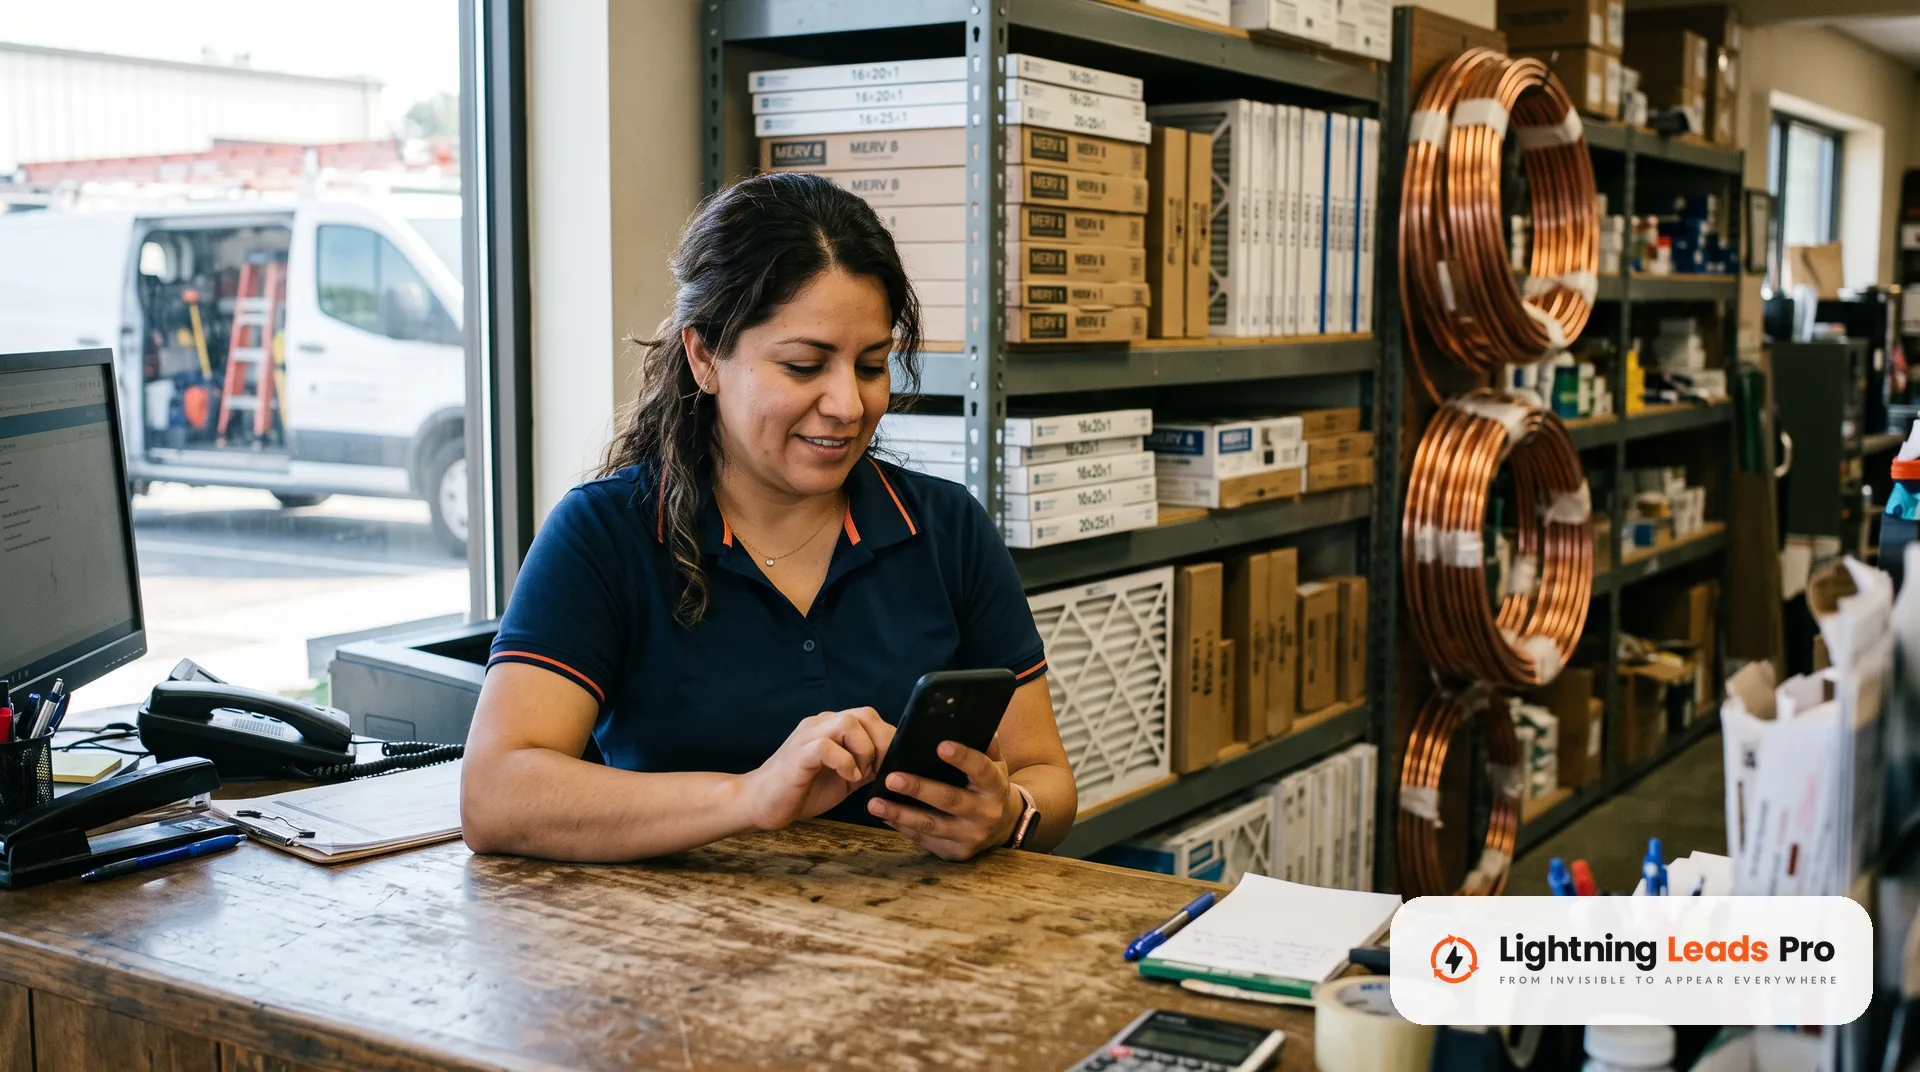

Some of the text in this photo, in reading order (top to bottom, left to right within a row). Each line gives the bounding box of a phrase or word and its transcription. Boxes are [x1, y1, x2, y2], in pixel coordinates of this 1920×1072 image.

[774, 142, 812, 158] MERV
[850, 139, 899, 154] MERV 8
[851, 178, 900, 191] MERV 8
